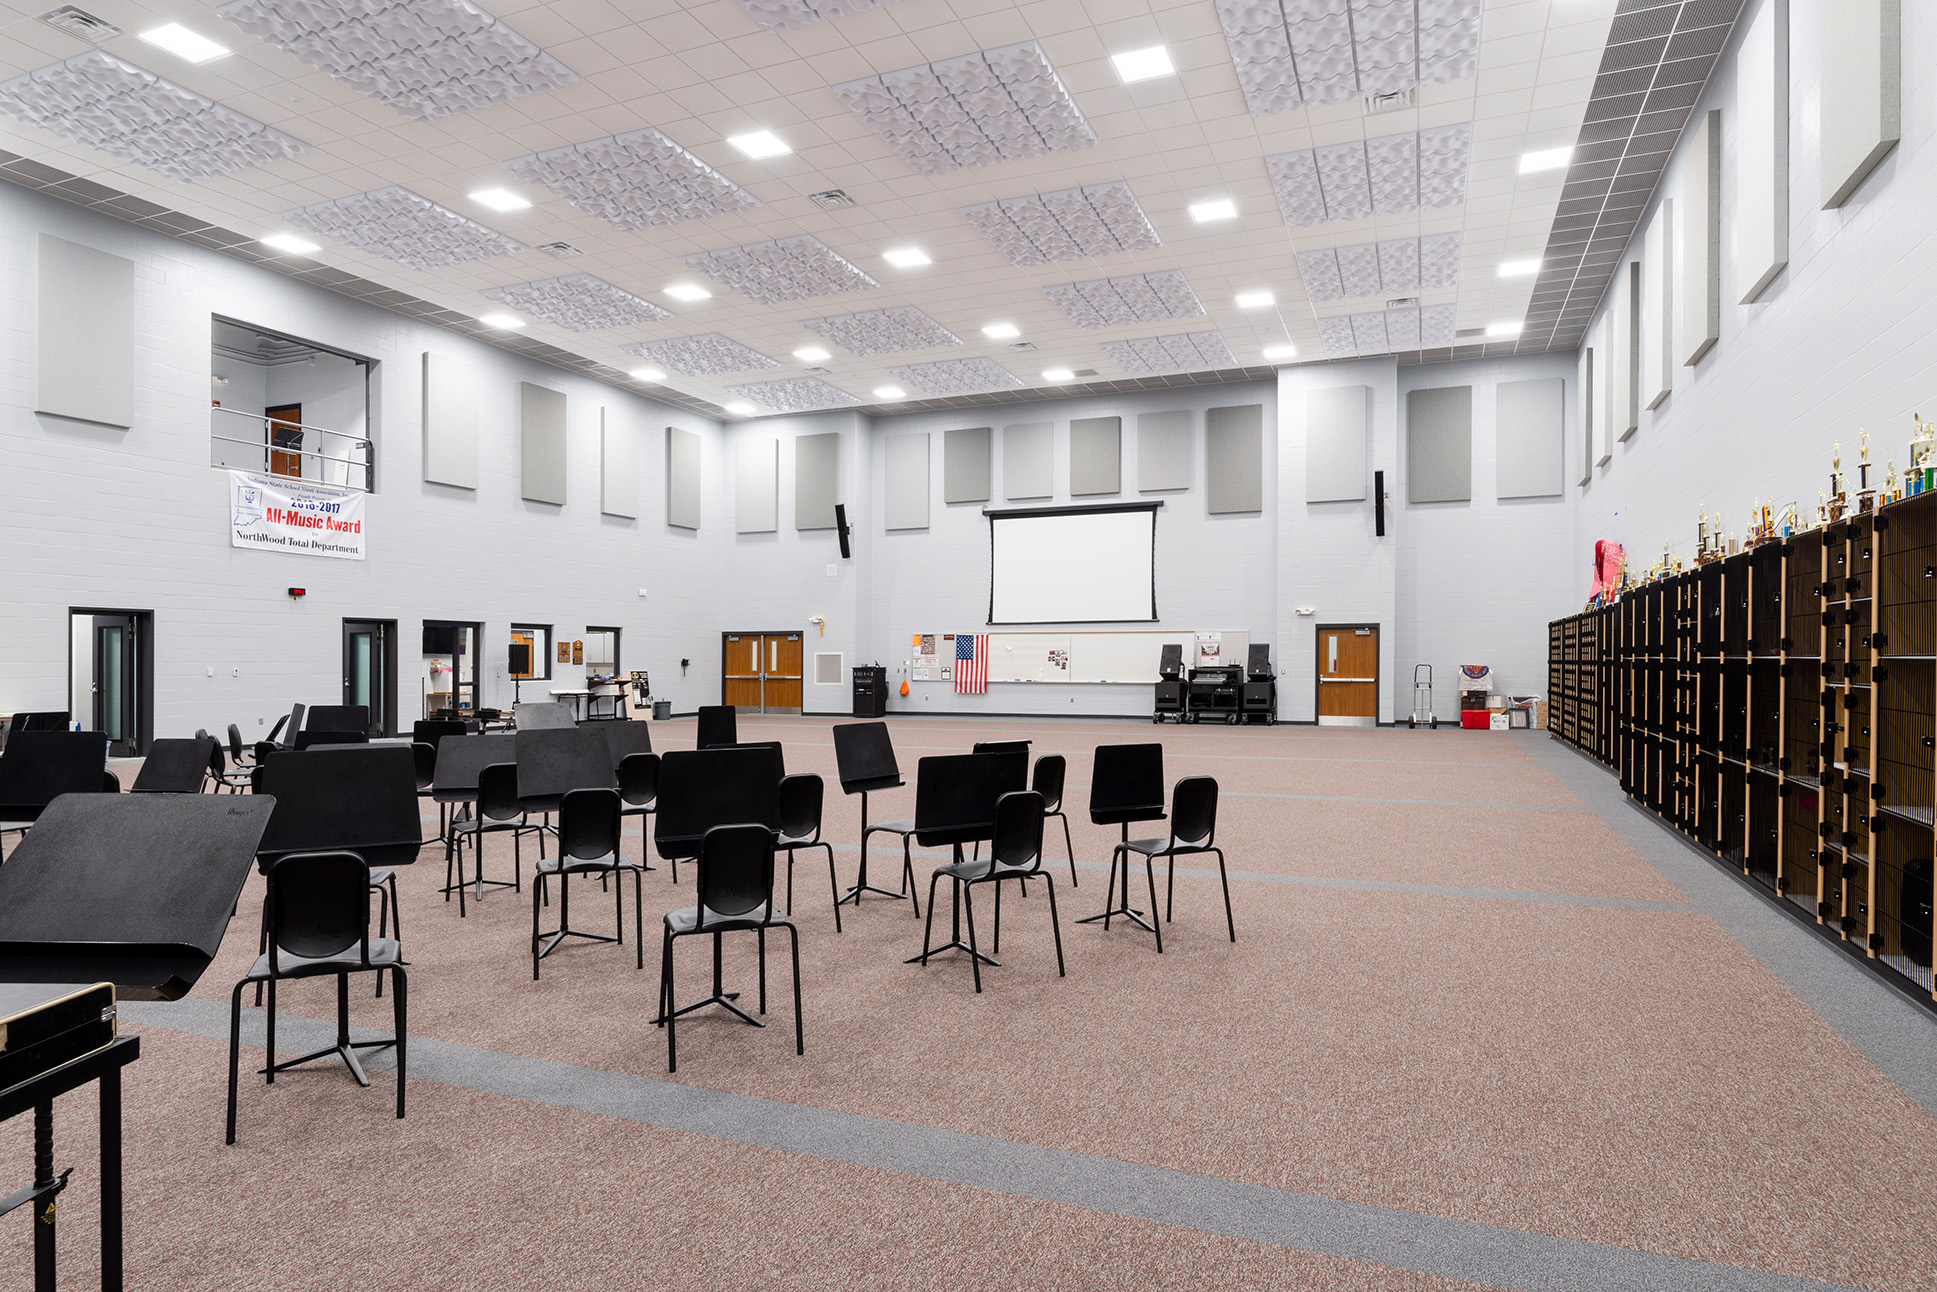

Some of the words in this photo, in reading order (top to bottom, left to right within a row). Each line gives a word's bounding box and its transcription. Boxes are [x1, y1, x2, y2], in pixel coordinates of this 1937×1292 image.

[247, 476, 269, 486] Indiana
[269, 481, 283, 489] State
[284, 483, 301, 491] School
[301, 486, 315, 494] Music
[266, 507, 324, 530] All-Music
[326, 516, 361, 534] Award
[236, 530, 286, 545] NorthWood
[287, 537, 309, 548] Total
[311, 540, 359, 555] Department
